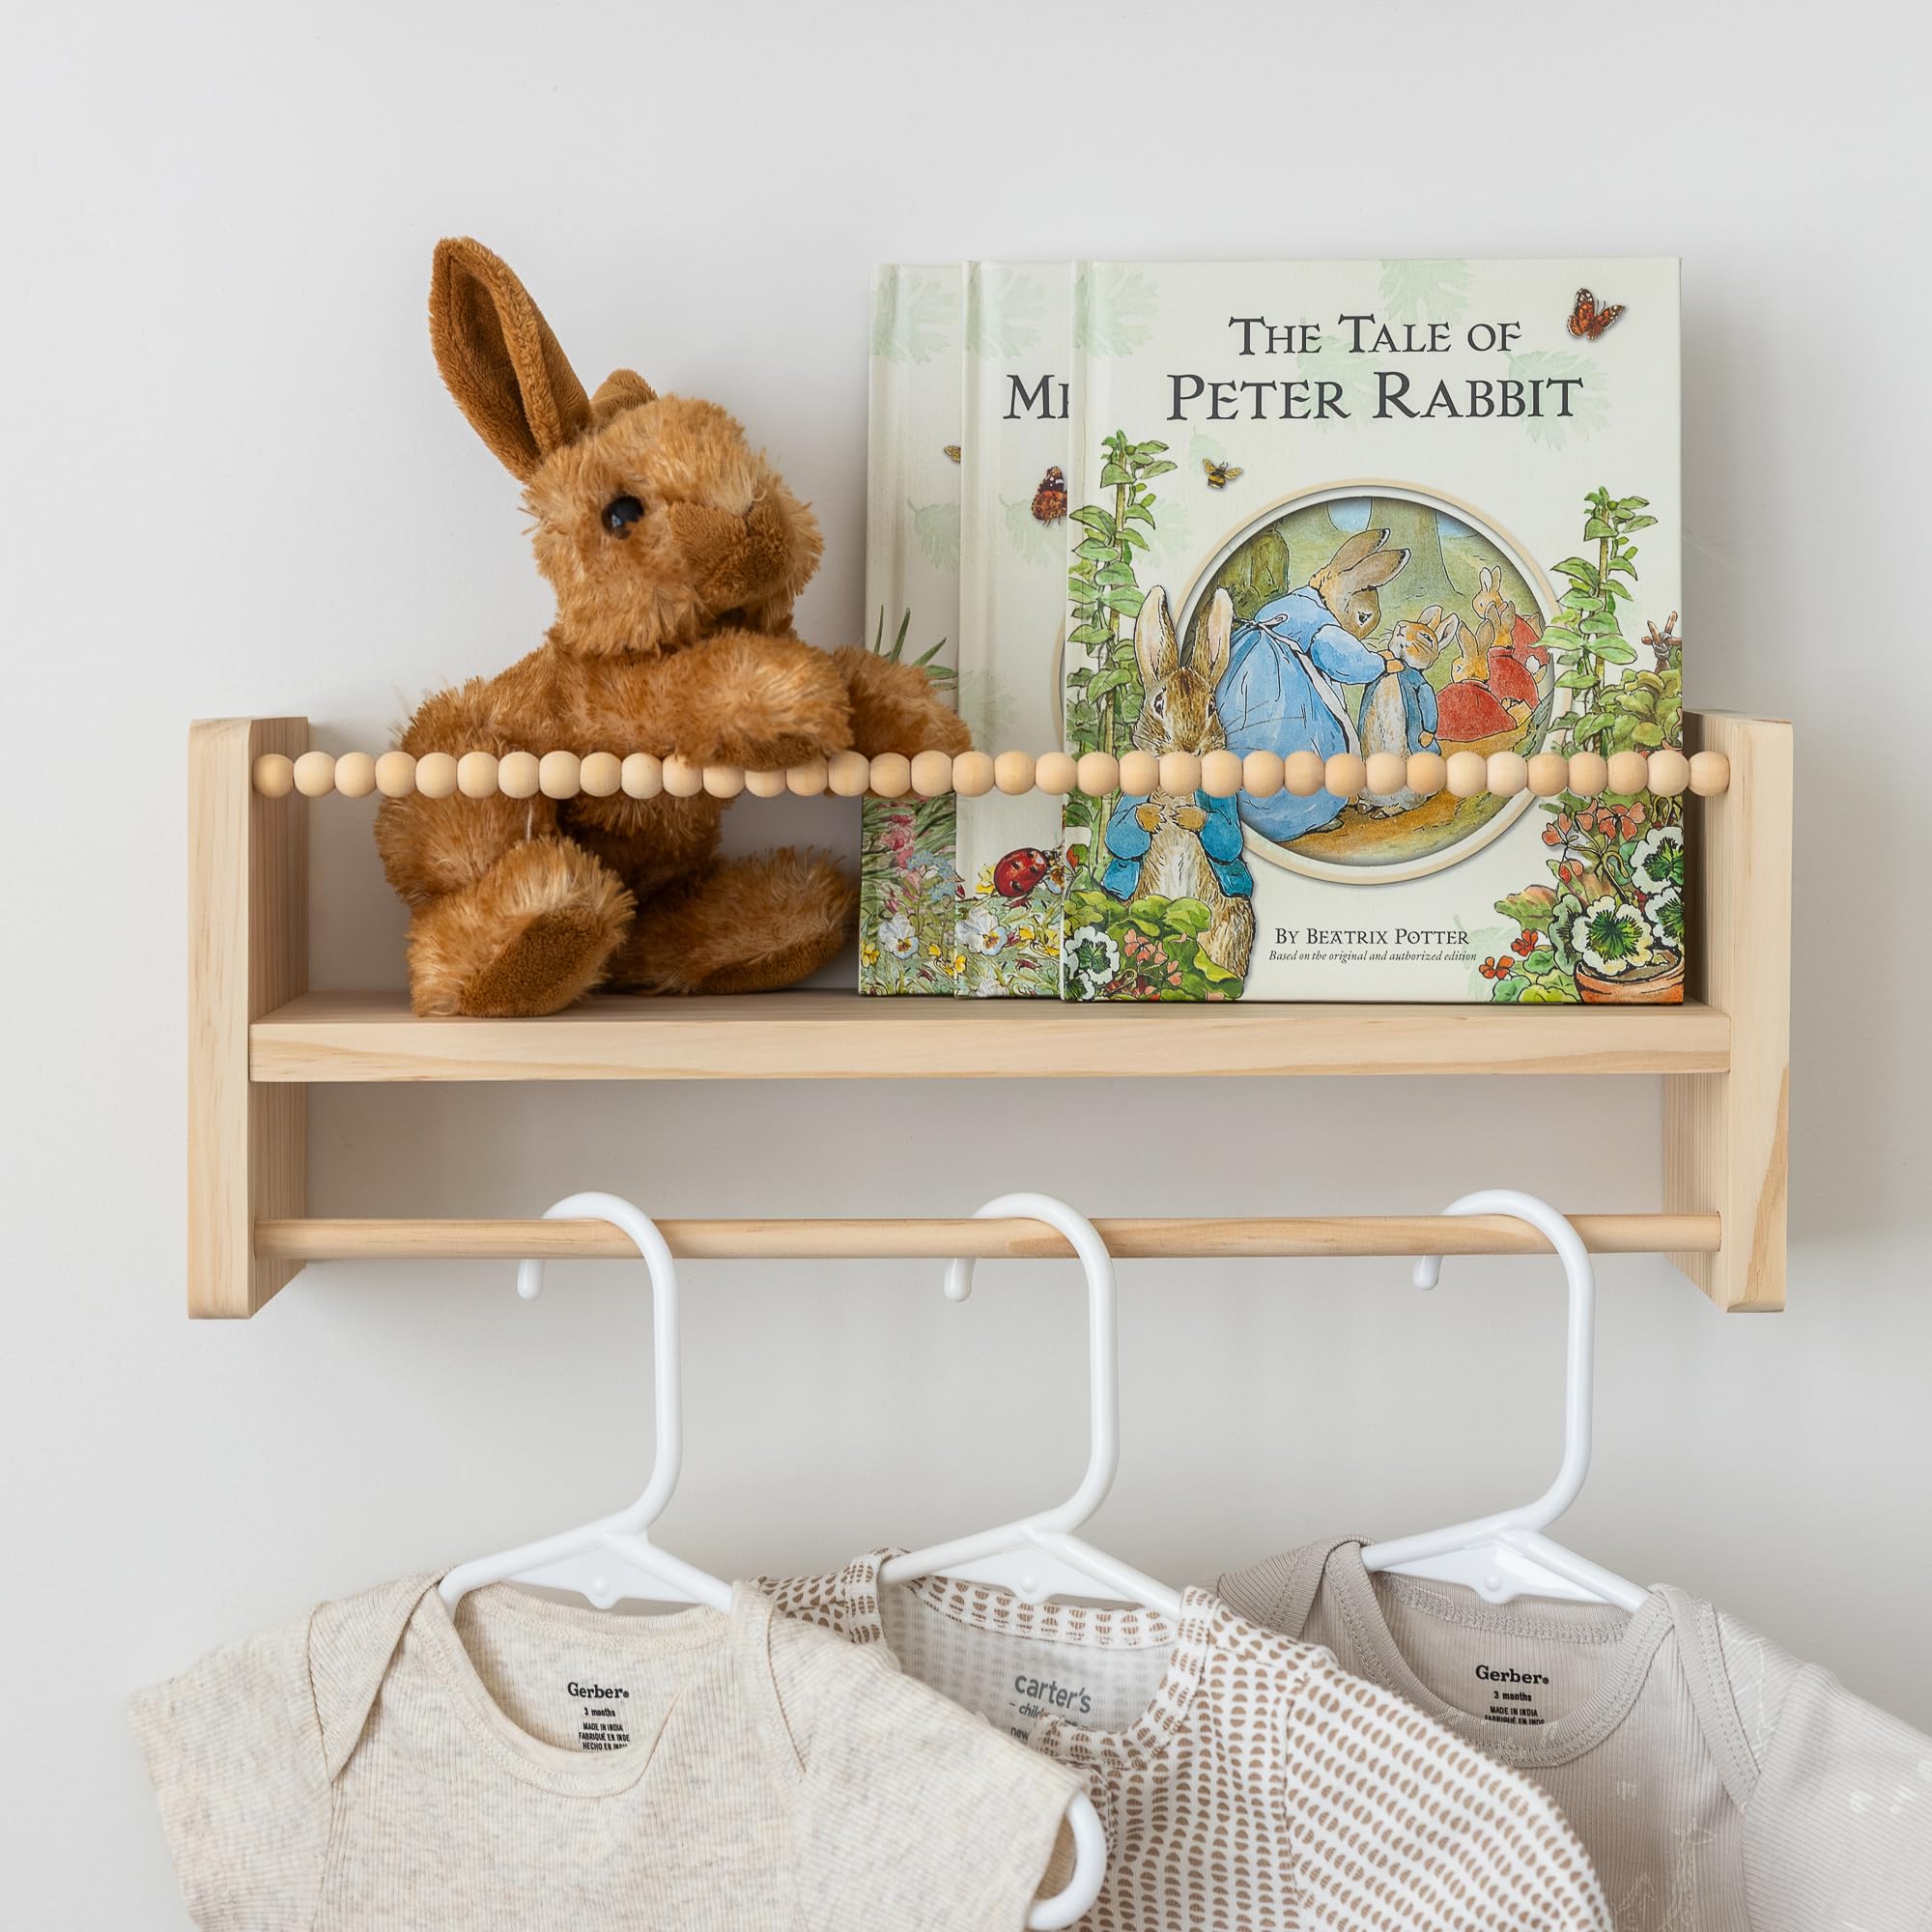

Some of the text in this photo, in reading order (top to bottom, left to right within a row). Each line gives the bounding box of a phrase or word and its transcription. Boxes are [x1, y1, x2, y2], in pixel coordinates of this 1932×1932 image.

[1166, 371, 1583, 421] PETER RABBIT
[1268, 949, 1477, 964] Based on the original and authorized edition
[1014, 1675, 1092, 1714] carter's
[1493, 1690, 1532, 1702] 3 months
[590, 1708, 616, 1718] months
[1490, 1705, 1538, 1717] MADE IN INDIA
[582, 1722, 599, 1731] MADE
[582, 1742, 603, 1751] HECHO
